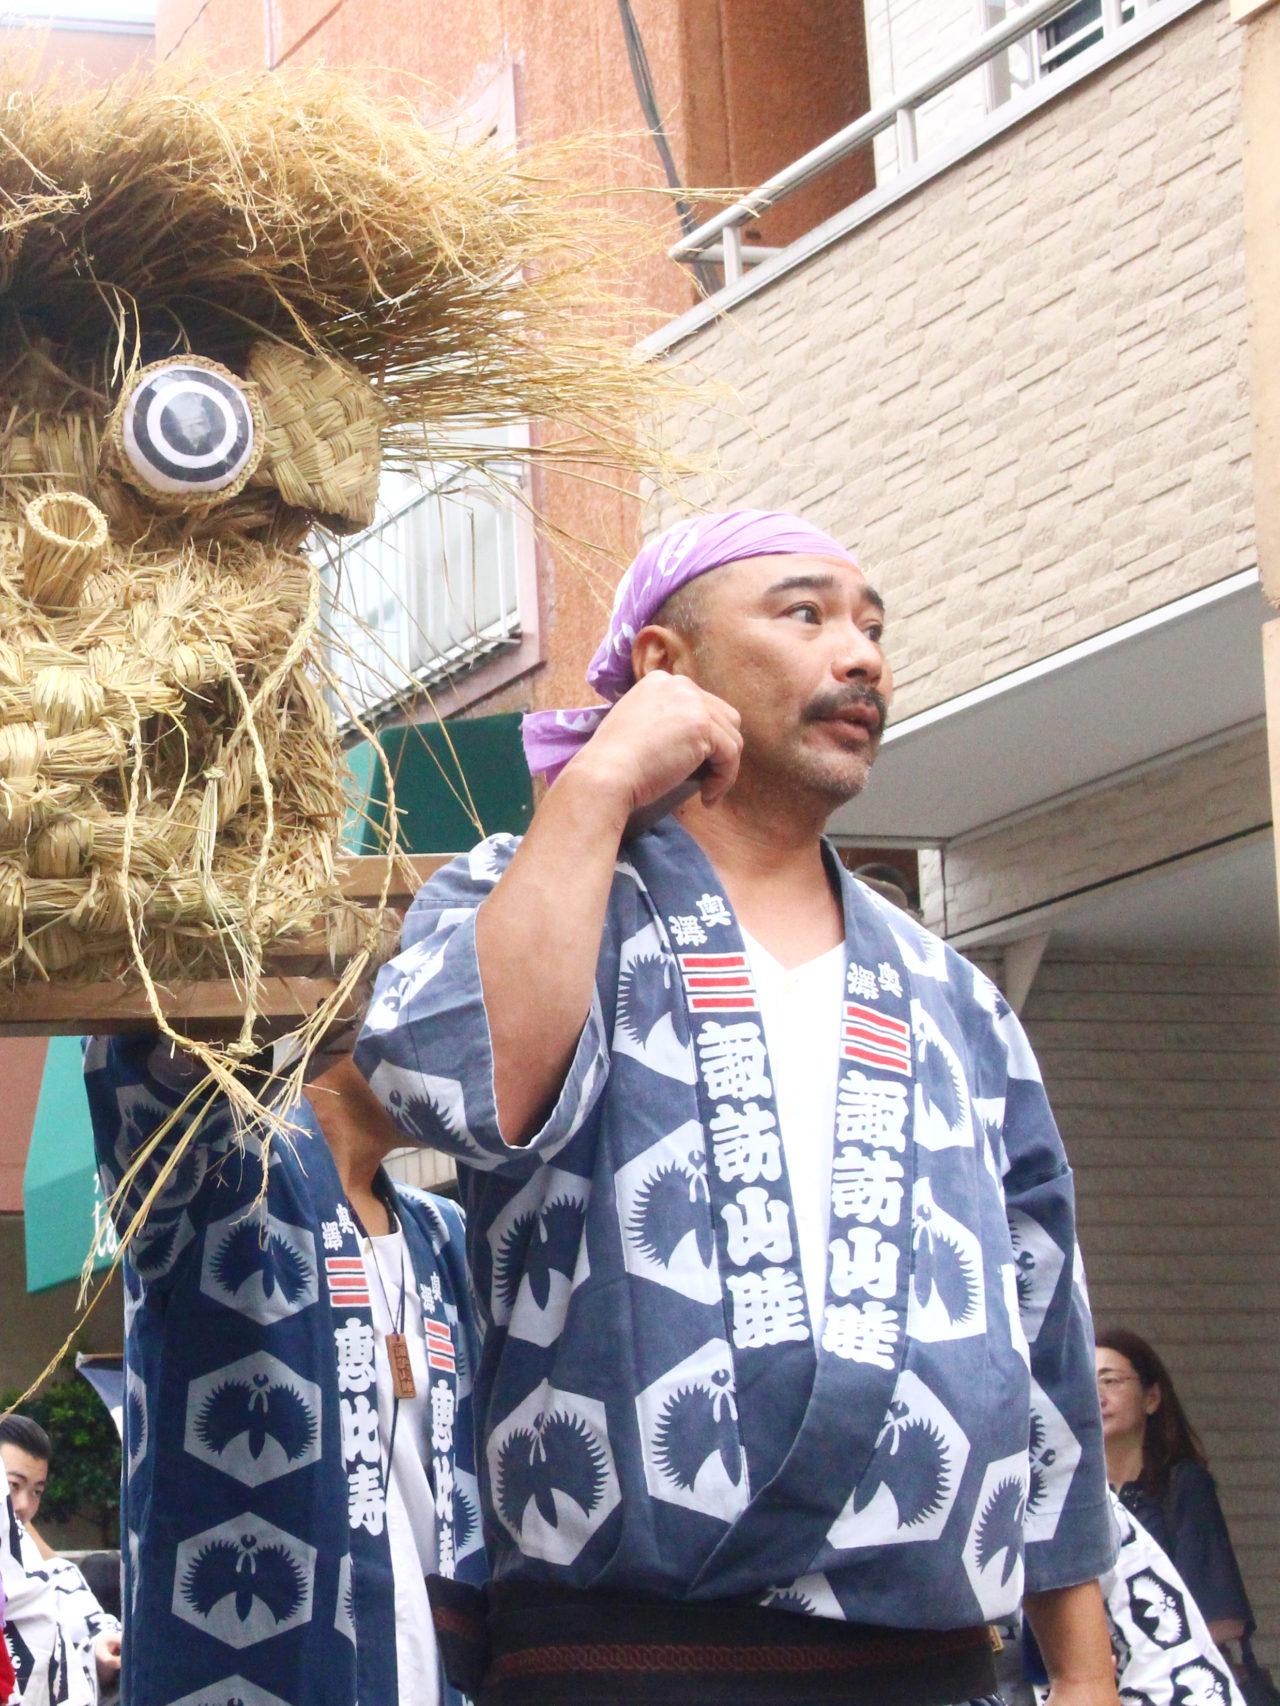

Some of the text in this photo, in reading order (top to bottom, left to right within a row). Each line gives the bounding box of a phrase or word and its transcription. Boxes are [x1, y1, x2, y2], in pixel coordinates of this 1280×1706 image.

[697, 1021, 810, 1350] 諏訪山睦
[822, 1071, 910, 1371] 諏訪山睦
